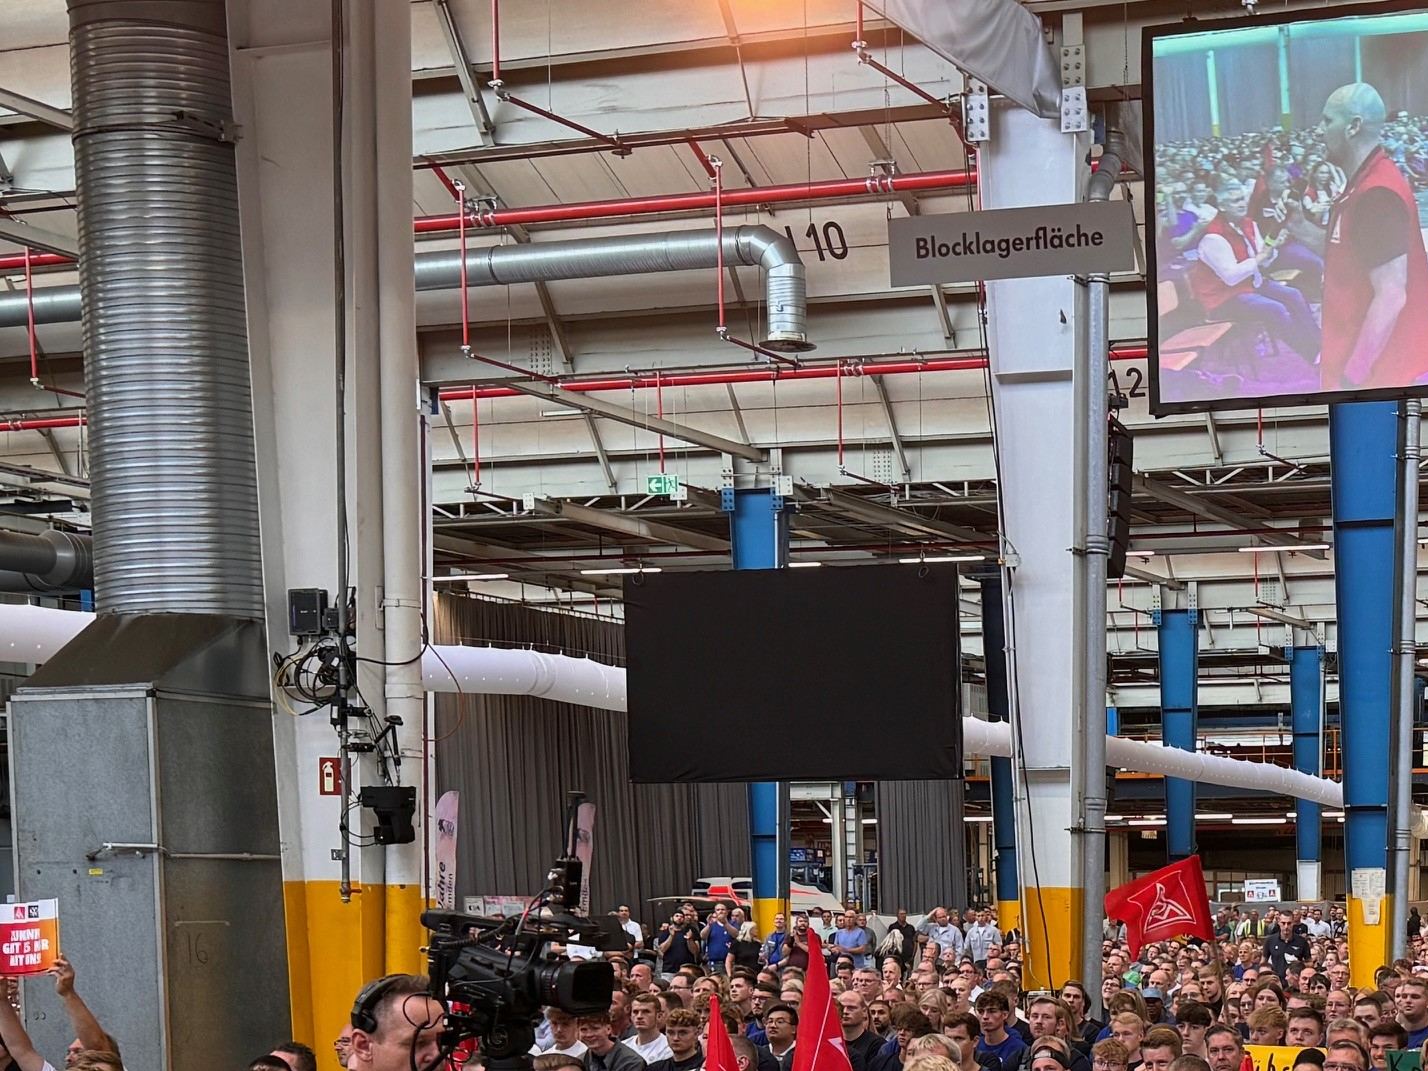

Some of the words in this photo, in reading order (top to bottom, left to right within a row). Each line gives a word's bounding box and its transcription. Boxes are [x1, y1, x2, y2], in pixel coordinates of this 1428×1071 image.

[785, 221, 848, 261] 10
[915, 224, 1104, 260] Blocklagerfläche
[187, 931, 208, 964] 16
